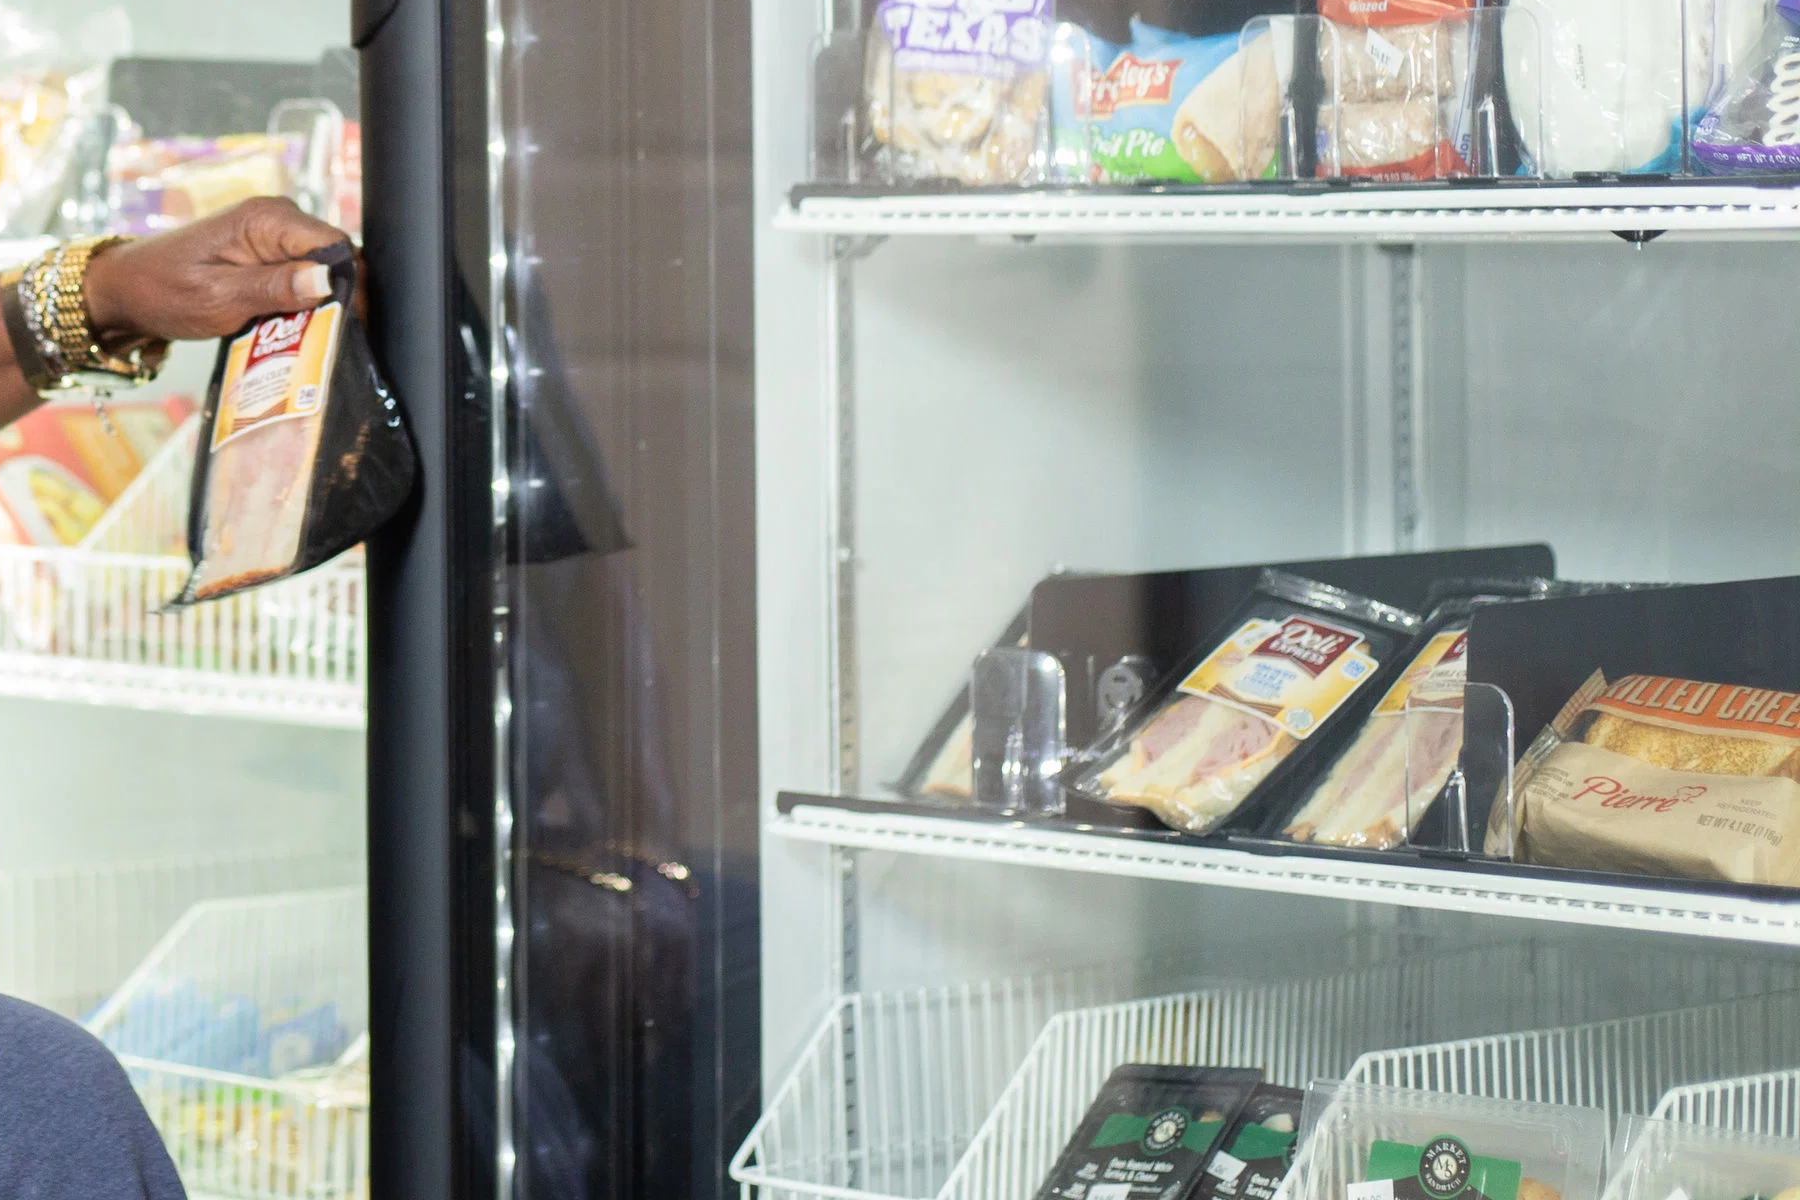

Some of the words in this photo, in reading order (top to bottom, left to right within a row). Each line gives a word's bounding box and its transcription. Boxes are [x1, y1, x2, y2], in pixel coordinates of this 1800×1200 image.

[884, 5, 1049, 64] TEXAS
[1125, 129, 1166, 158] Pie
[257, 311, 310, 345] Deli
[1268, 639, 1327, 666] EXPRESS
[1281, 623, 1345, 655] Deli
[1716, 685, 1800, 728] CHEE
[1572, 776, 1681, 813] Pierre
[1714, 817, 1729, 829] WT
[1426, 1142, 1467, 1165] MARKET
[1425, 1173, 1462, 1191] SANDWICH
